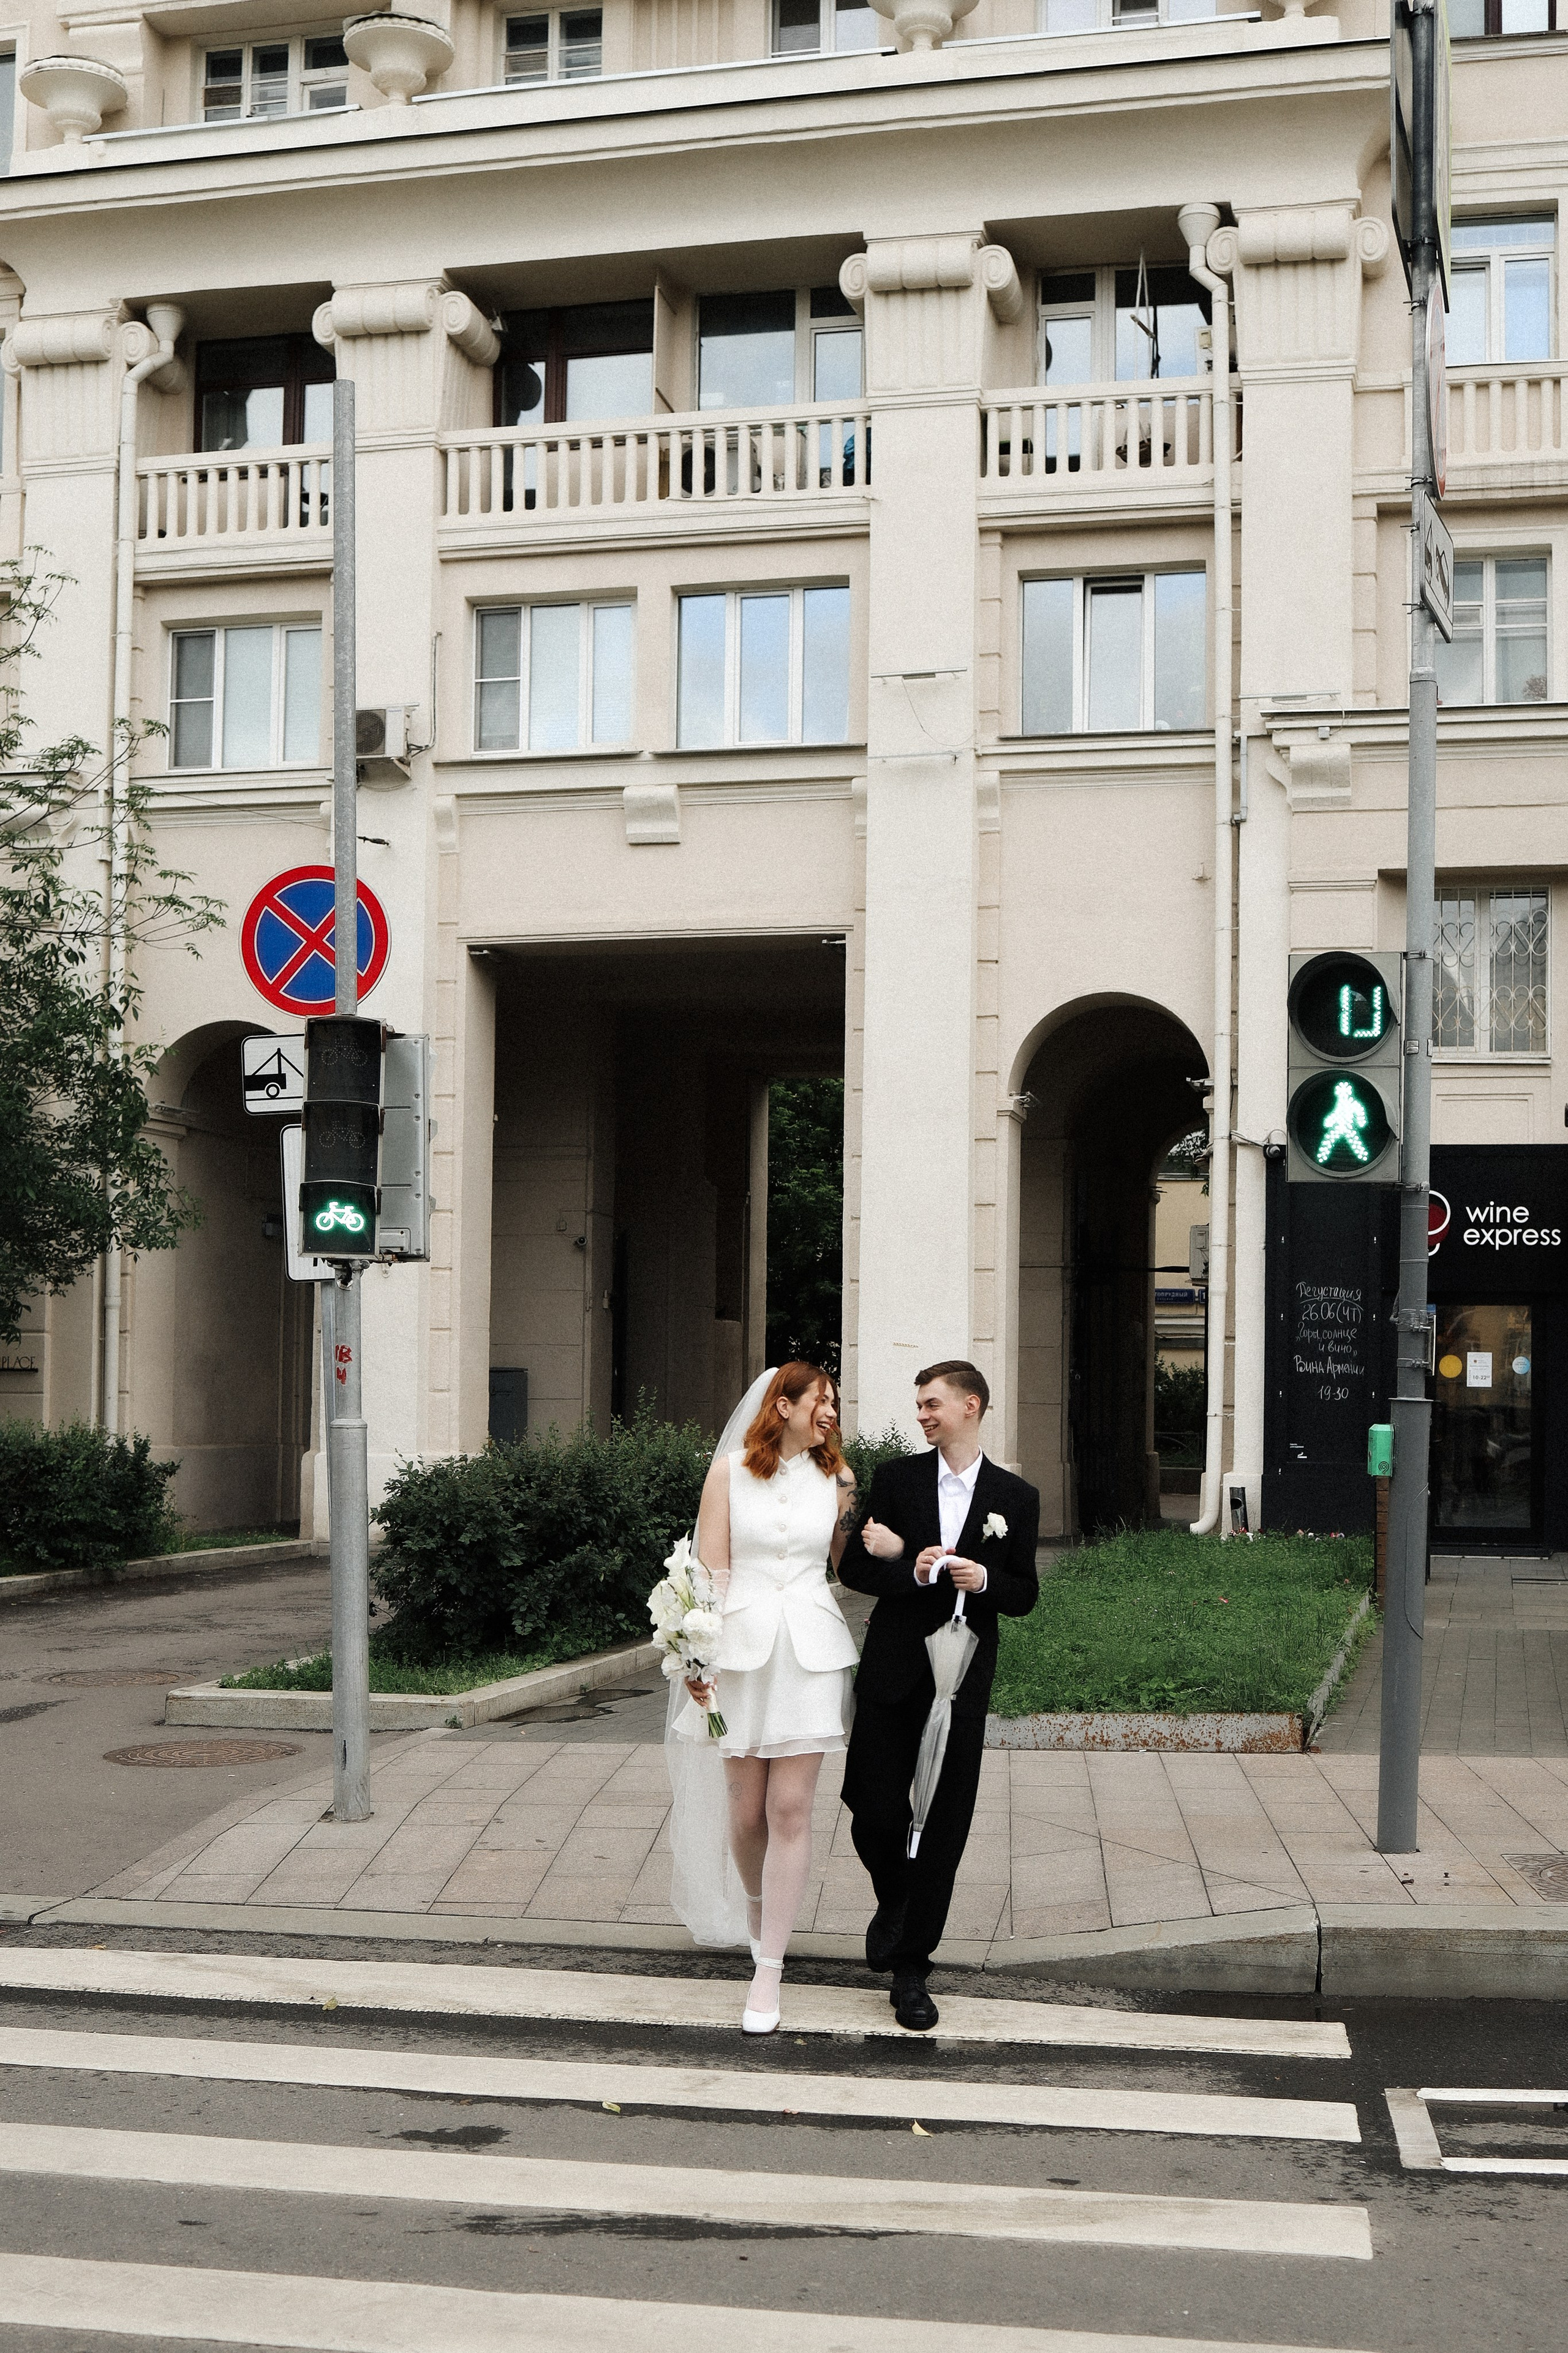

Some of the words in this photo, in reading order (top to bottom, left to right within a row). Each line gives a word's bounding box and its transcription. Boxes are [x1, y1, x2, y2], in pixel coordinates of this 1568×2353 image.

[1466, 1201, 1529, 1223] wine
[1463, 1228, 1561, 1250] express
[1296, 1282, 1362, 1303] Дегустация
[1322, 1328, 1357, 1343] солнце
[1317, 1386, 1349, 1401] 19-30
